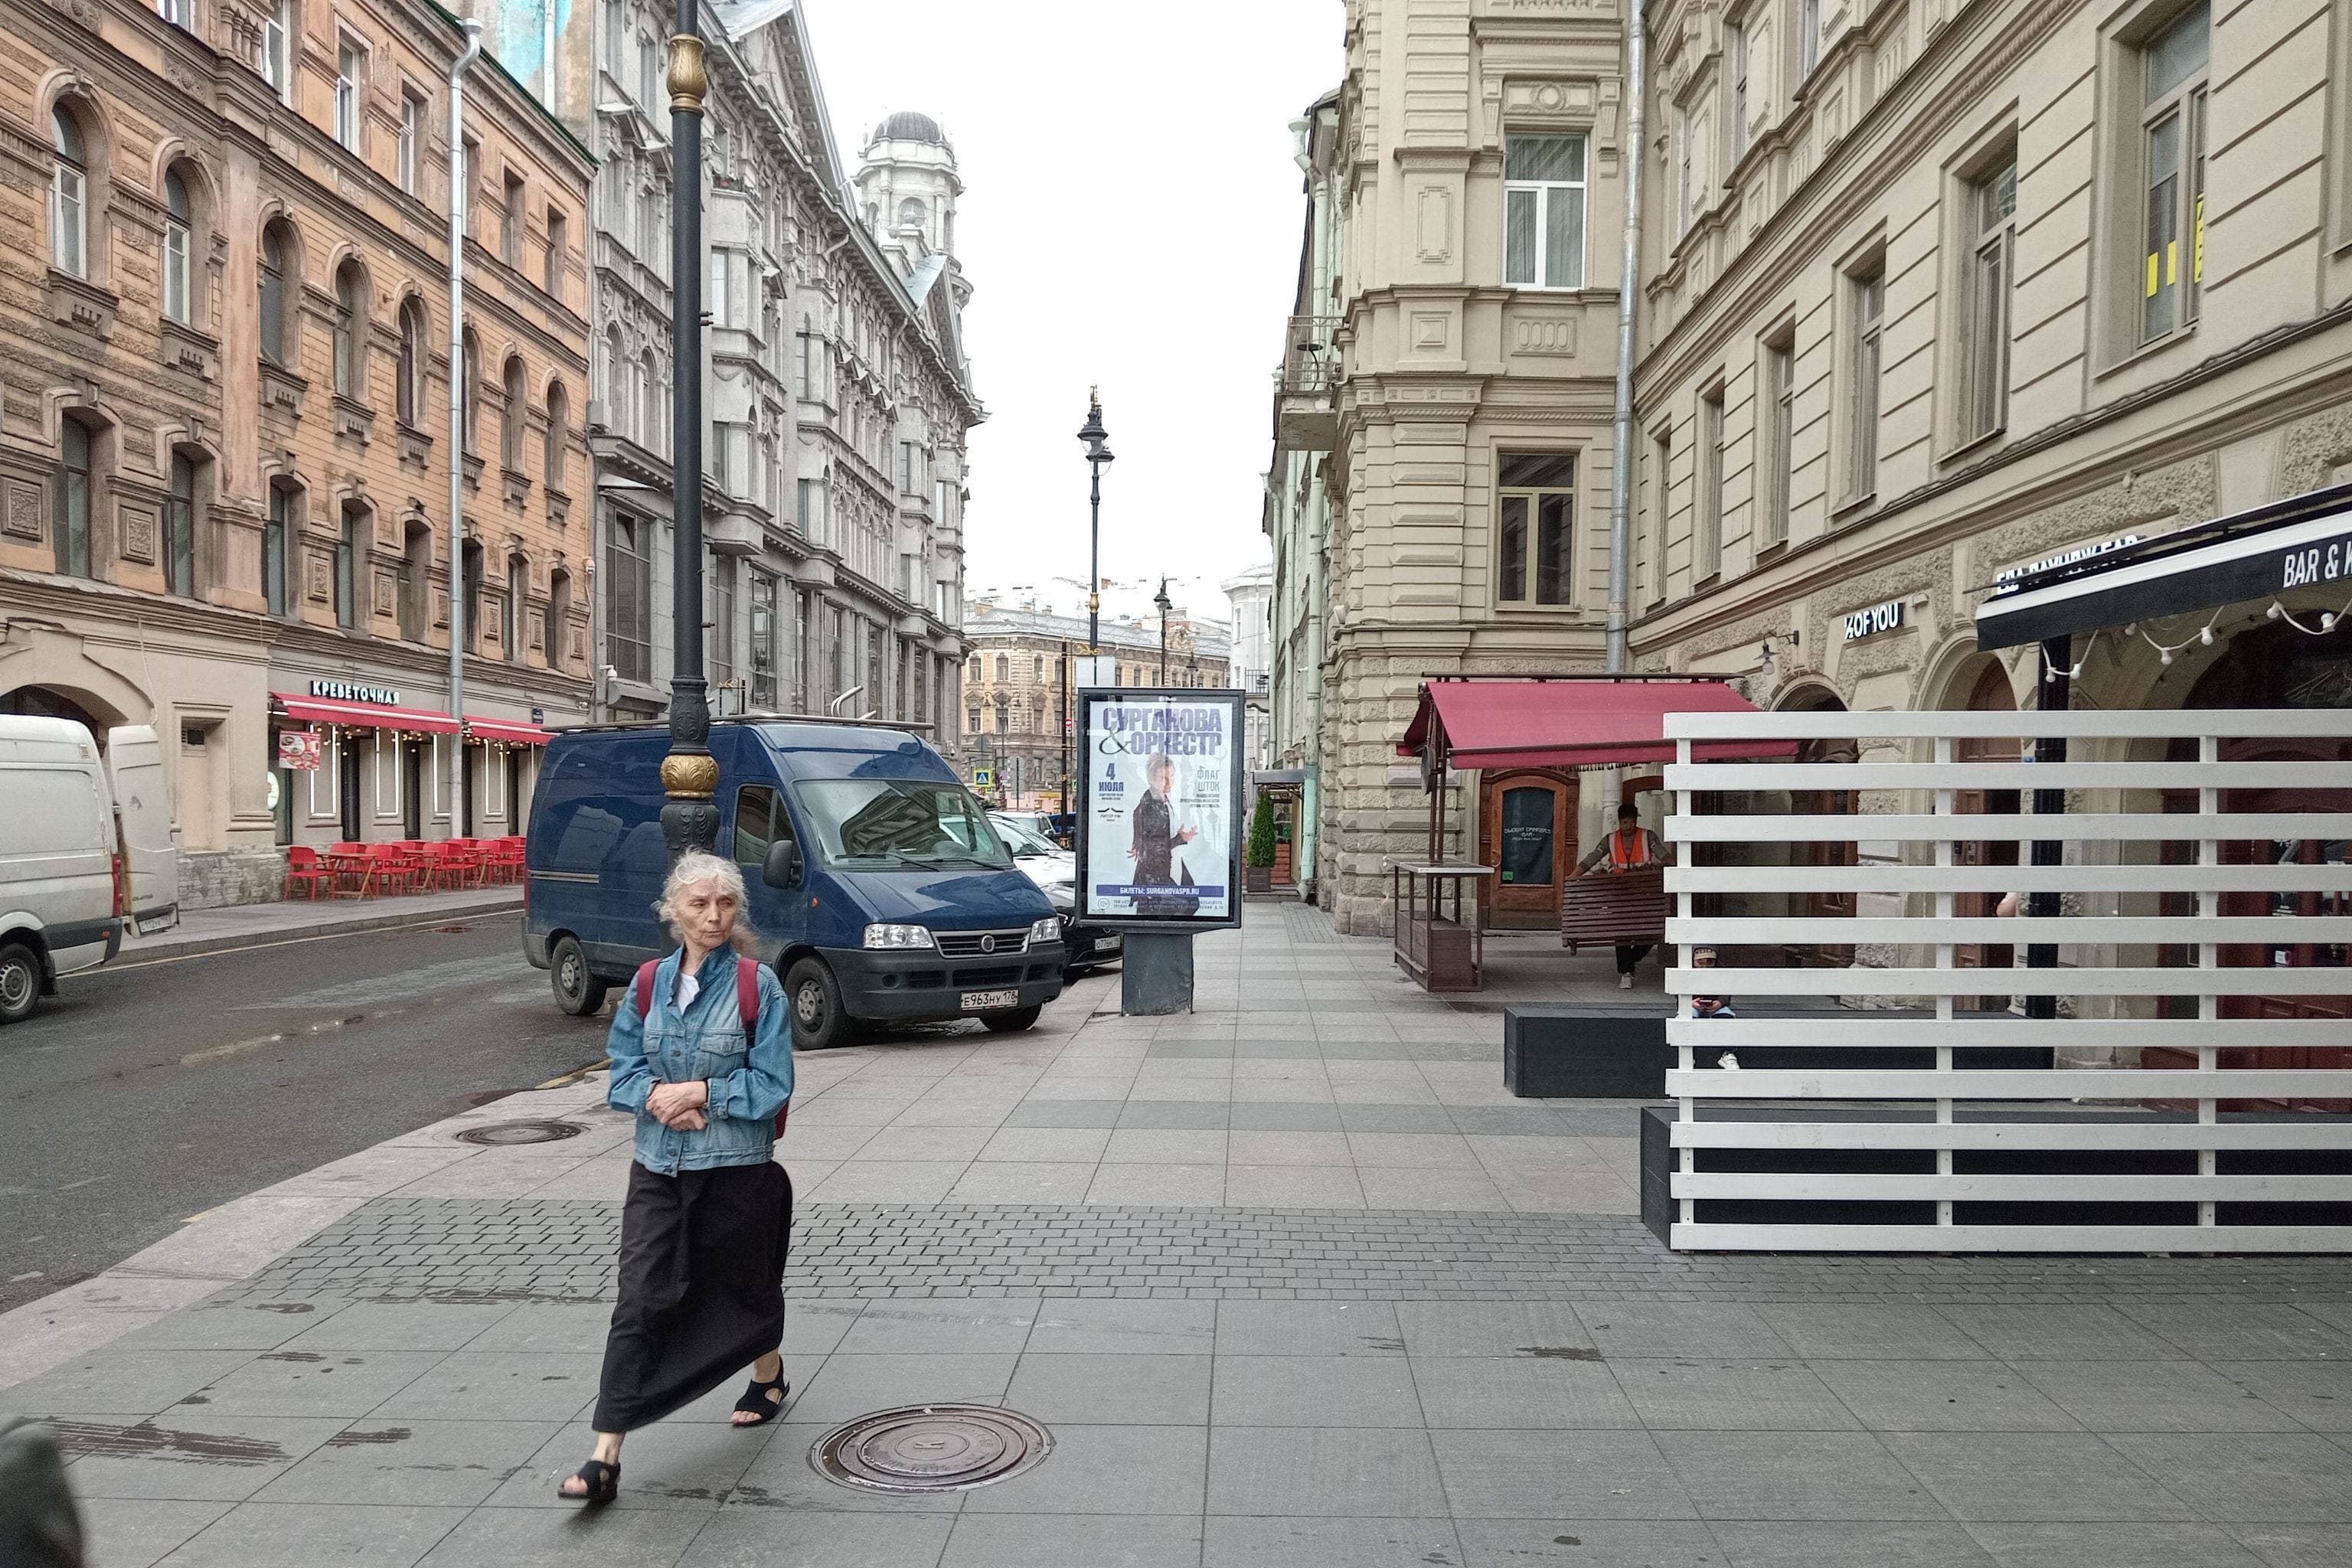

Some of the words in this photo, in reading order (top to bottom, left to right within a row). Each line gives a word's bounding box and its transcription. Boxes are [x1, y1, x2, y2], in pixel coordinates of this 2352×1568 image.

[2282, 547, 2320, 589] BAR
[2324, 543, 2340, 580] &
[1870, 601, 1899, 633] YOU
[312, 680, 400, 704] КРЕВЕТОЧНАЯ
[1102, 707, 1223, 732] СУРГАНОВА
[1106, 763, 1116, 780] 4
[1197, 765, 1221, 780] ФЛАГ
[1099, 782, 1124, 792] ИЮЛЯ
[1198, 781, 1220, 792] ШТОК
[1146, 887, 1200, 895] SURGANOVASPB.RU
[964, 993, 1001, 1006] Е963НУ
[1003, 991, 1015, 1000] 178
